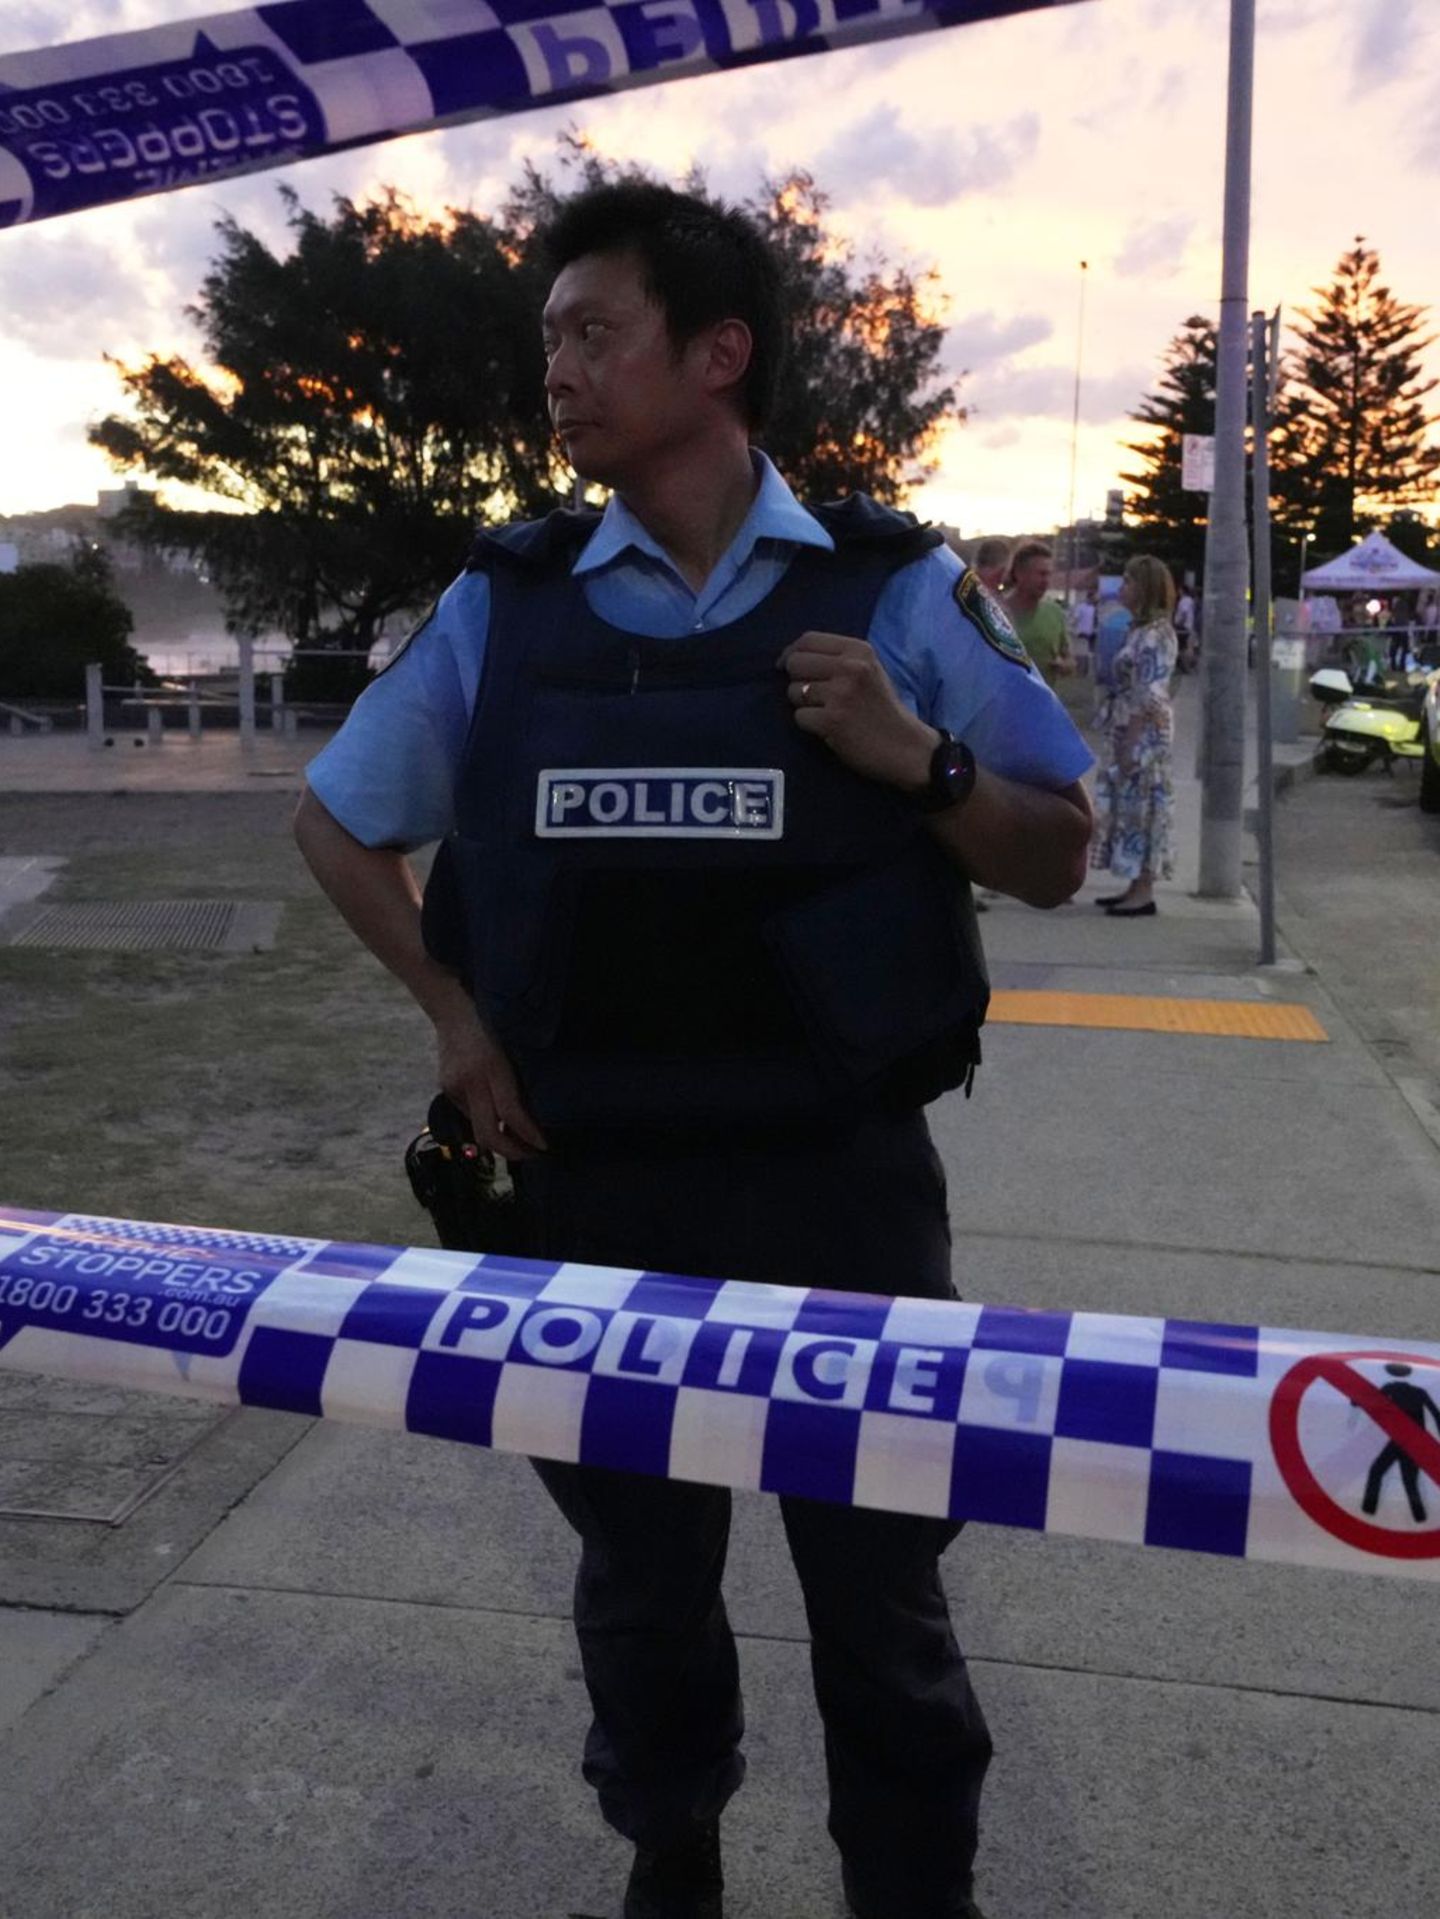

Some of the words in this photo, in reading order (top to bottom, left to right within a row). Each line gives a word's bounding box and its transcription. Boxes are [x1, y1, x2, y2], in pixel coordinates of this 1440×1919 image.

[27, 94, 308, 180] STOPPERS
[551, 782, 768, 825] POLICE
[20, 1246, 261, 1294] STOPPERS
[0, 1275, 78, 1313] 1800
[83, 1290, 153, 1327] 333
[157, 1302, 231, 1340] 000
[438, 1295, 944, 1414] POLICE
